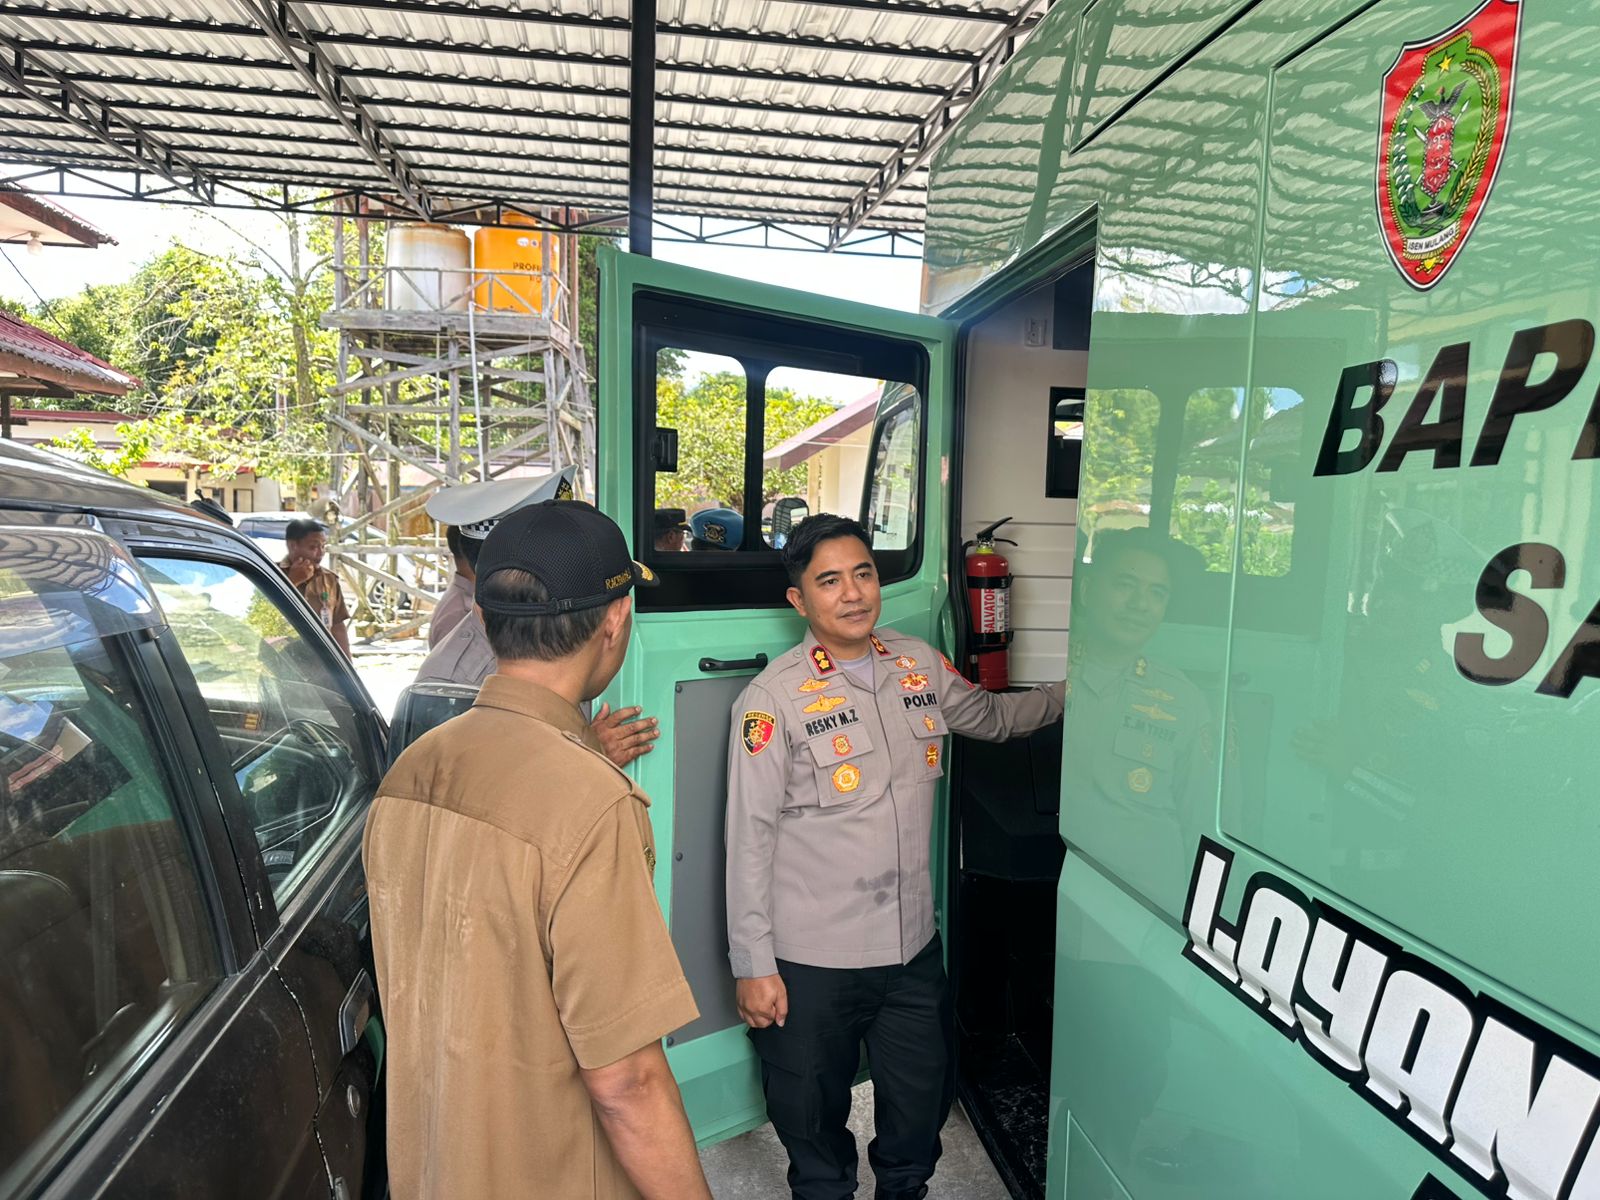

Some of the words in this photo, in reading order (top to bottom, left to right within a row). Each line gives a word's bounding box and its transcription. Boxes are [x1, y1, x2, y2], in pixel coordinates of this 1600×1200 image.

[1408, 241, 1424, 251] ISEN
[1424, 227, 1455, 248] MULANG
[513, 261, 542, 272] PROFI
[1313, 318, 1600, 477] BAP
[903, 692, 938, 710] POLRI
[804, 713, 838, 737] RESKY
[838, 708, 860, 726] M.Z
[1182, 834, 1600, 1200] LAYAN
